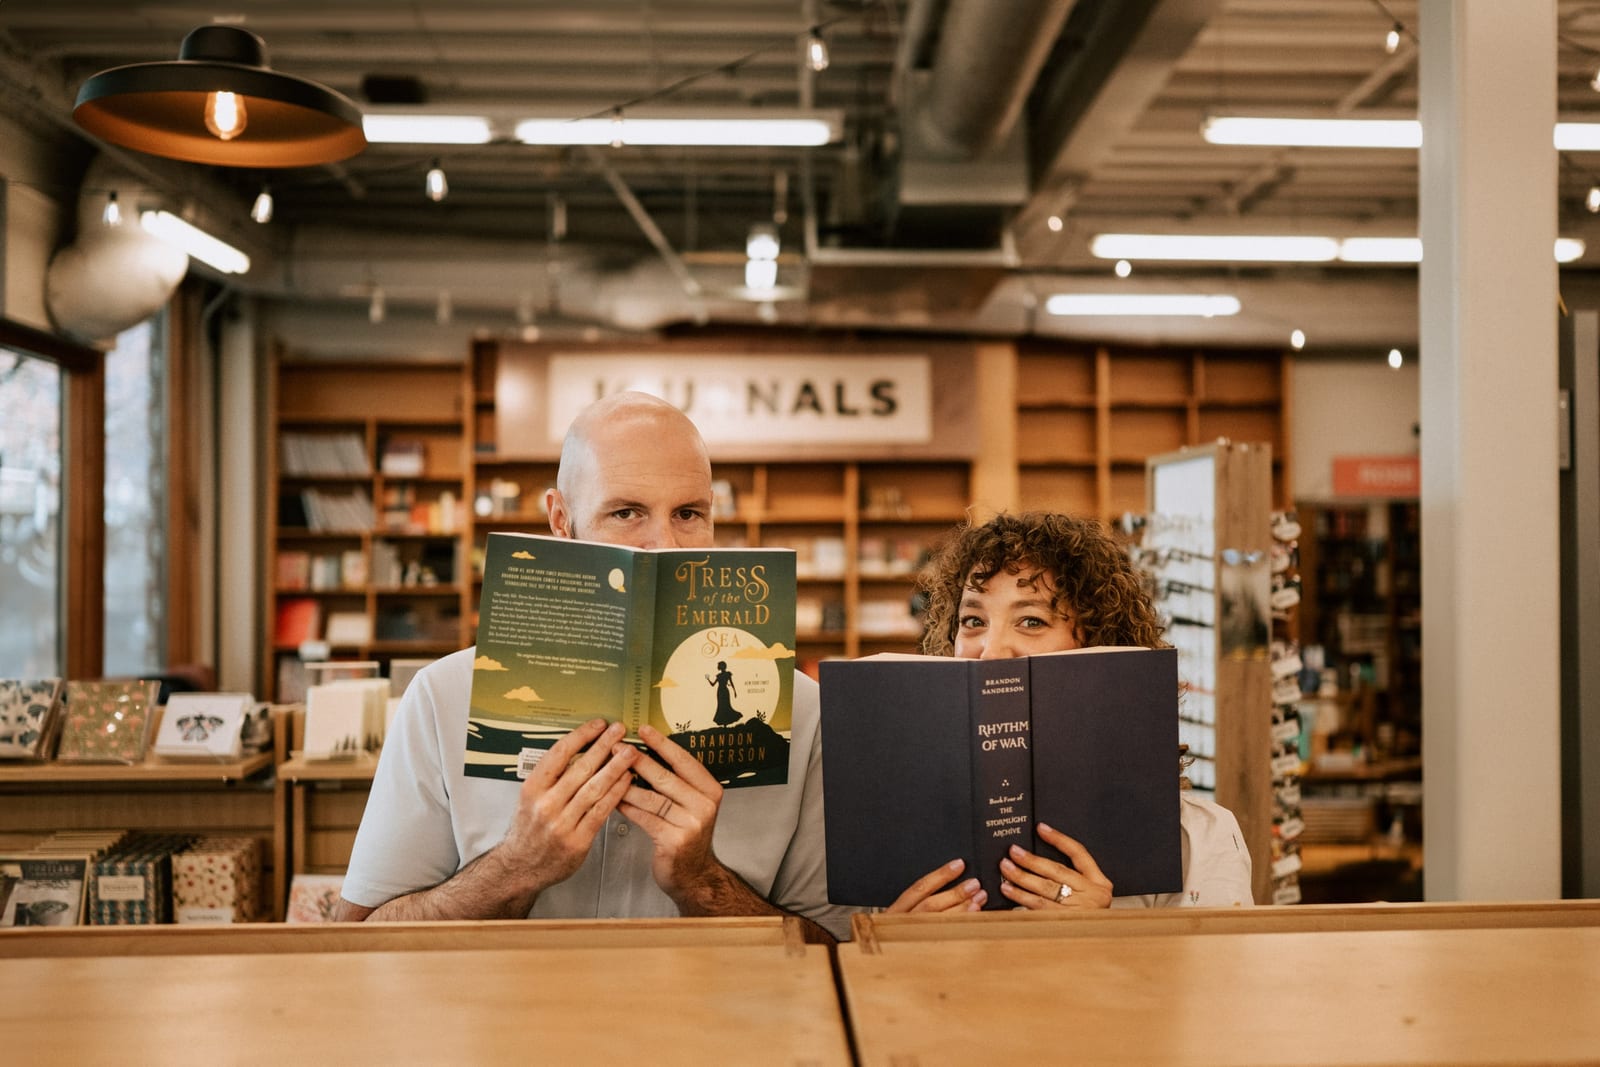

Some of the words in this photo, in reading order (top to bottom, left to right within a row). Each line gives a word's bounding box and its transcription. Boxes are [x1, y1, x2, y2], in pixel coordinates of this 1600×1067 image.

[594, 377, 898, 416] JUNALS
[675, 555, 769, 604] TRESS
[703, 592, 718, 606] of
[721, 593, 740, 603] the
[676, 604, 770, 626] EMERALD
[702, 630, 740, 658] SEA
[985, 677, 1021, 686] BRANDON
[981, 686, 1025, 695] SANDERSON
[978, 721, 1029, 738] RHYTHM
[690, 732, 753, 748] BRANDON
[982, 740, 998, 751] OF
[1000, 737, 1028, 749] WAR
[696, 747, 766, 764] NDERSON
[1000, 806, 1013, 814] THE
[985, 815, 1028, 827] STORMLIGHT
[992, 827, 1022, 837] ARCHIVE
